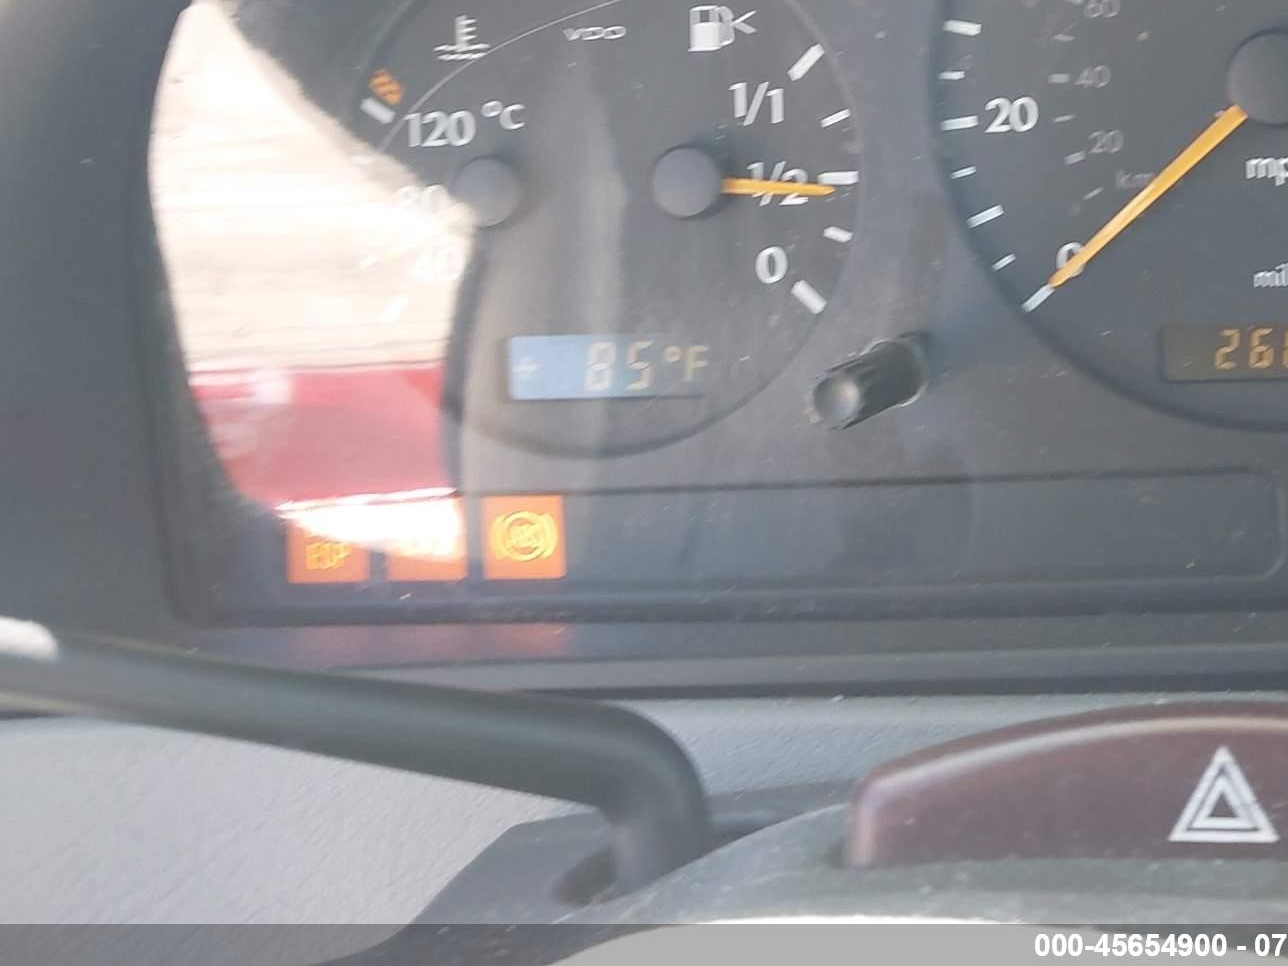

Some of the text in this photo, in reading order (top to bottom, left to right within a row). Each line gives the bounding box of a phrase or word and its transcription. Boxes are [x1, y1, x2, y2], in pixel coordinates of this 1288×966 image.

[1077, 66, 1111, 89] 40
[729, 80, 784, 126] 1/1
[984, 96, 1039, 133] 20
[405, 109, 476, 147] 120
[1089, 130, 1124, 153] 20
[746, 161, 808, 207] 1/2
[755, 246, 789, 284] 0
